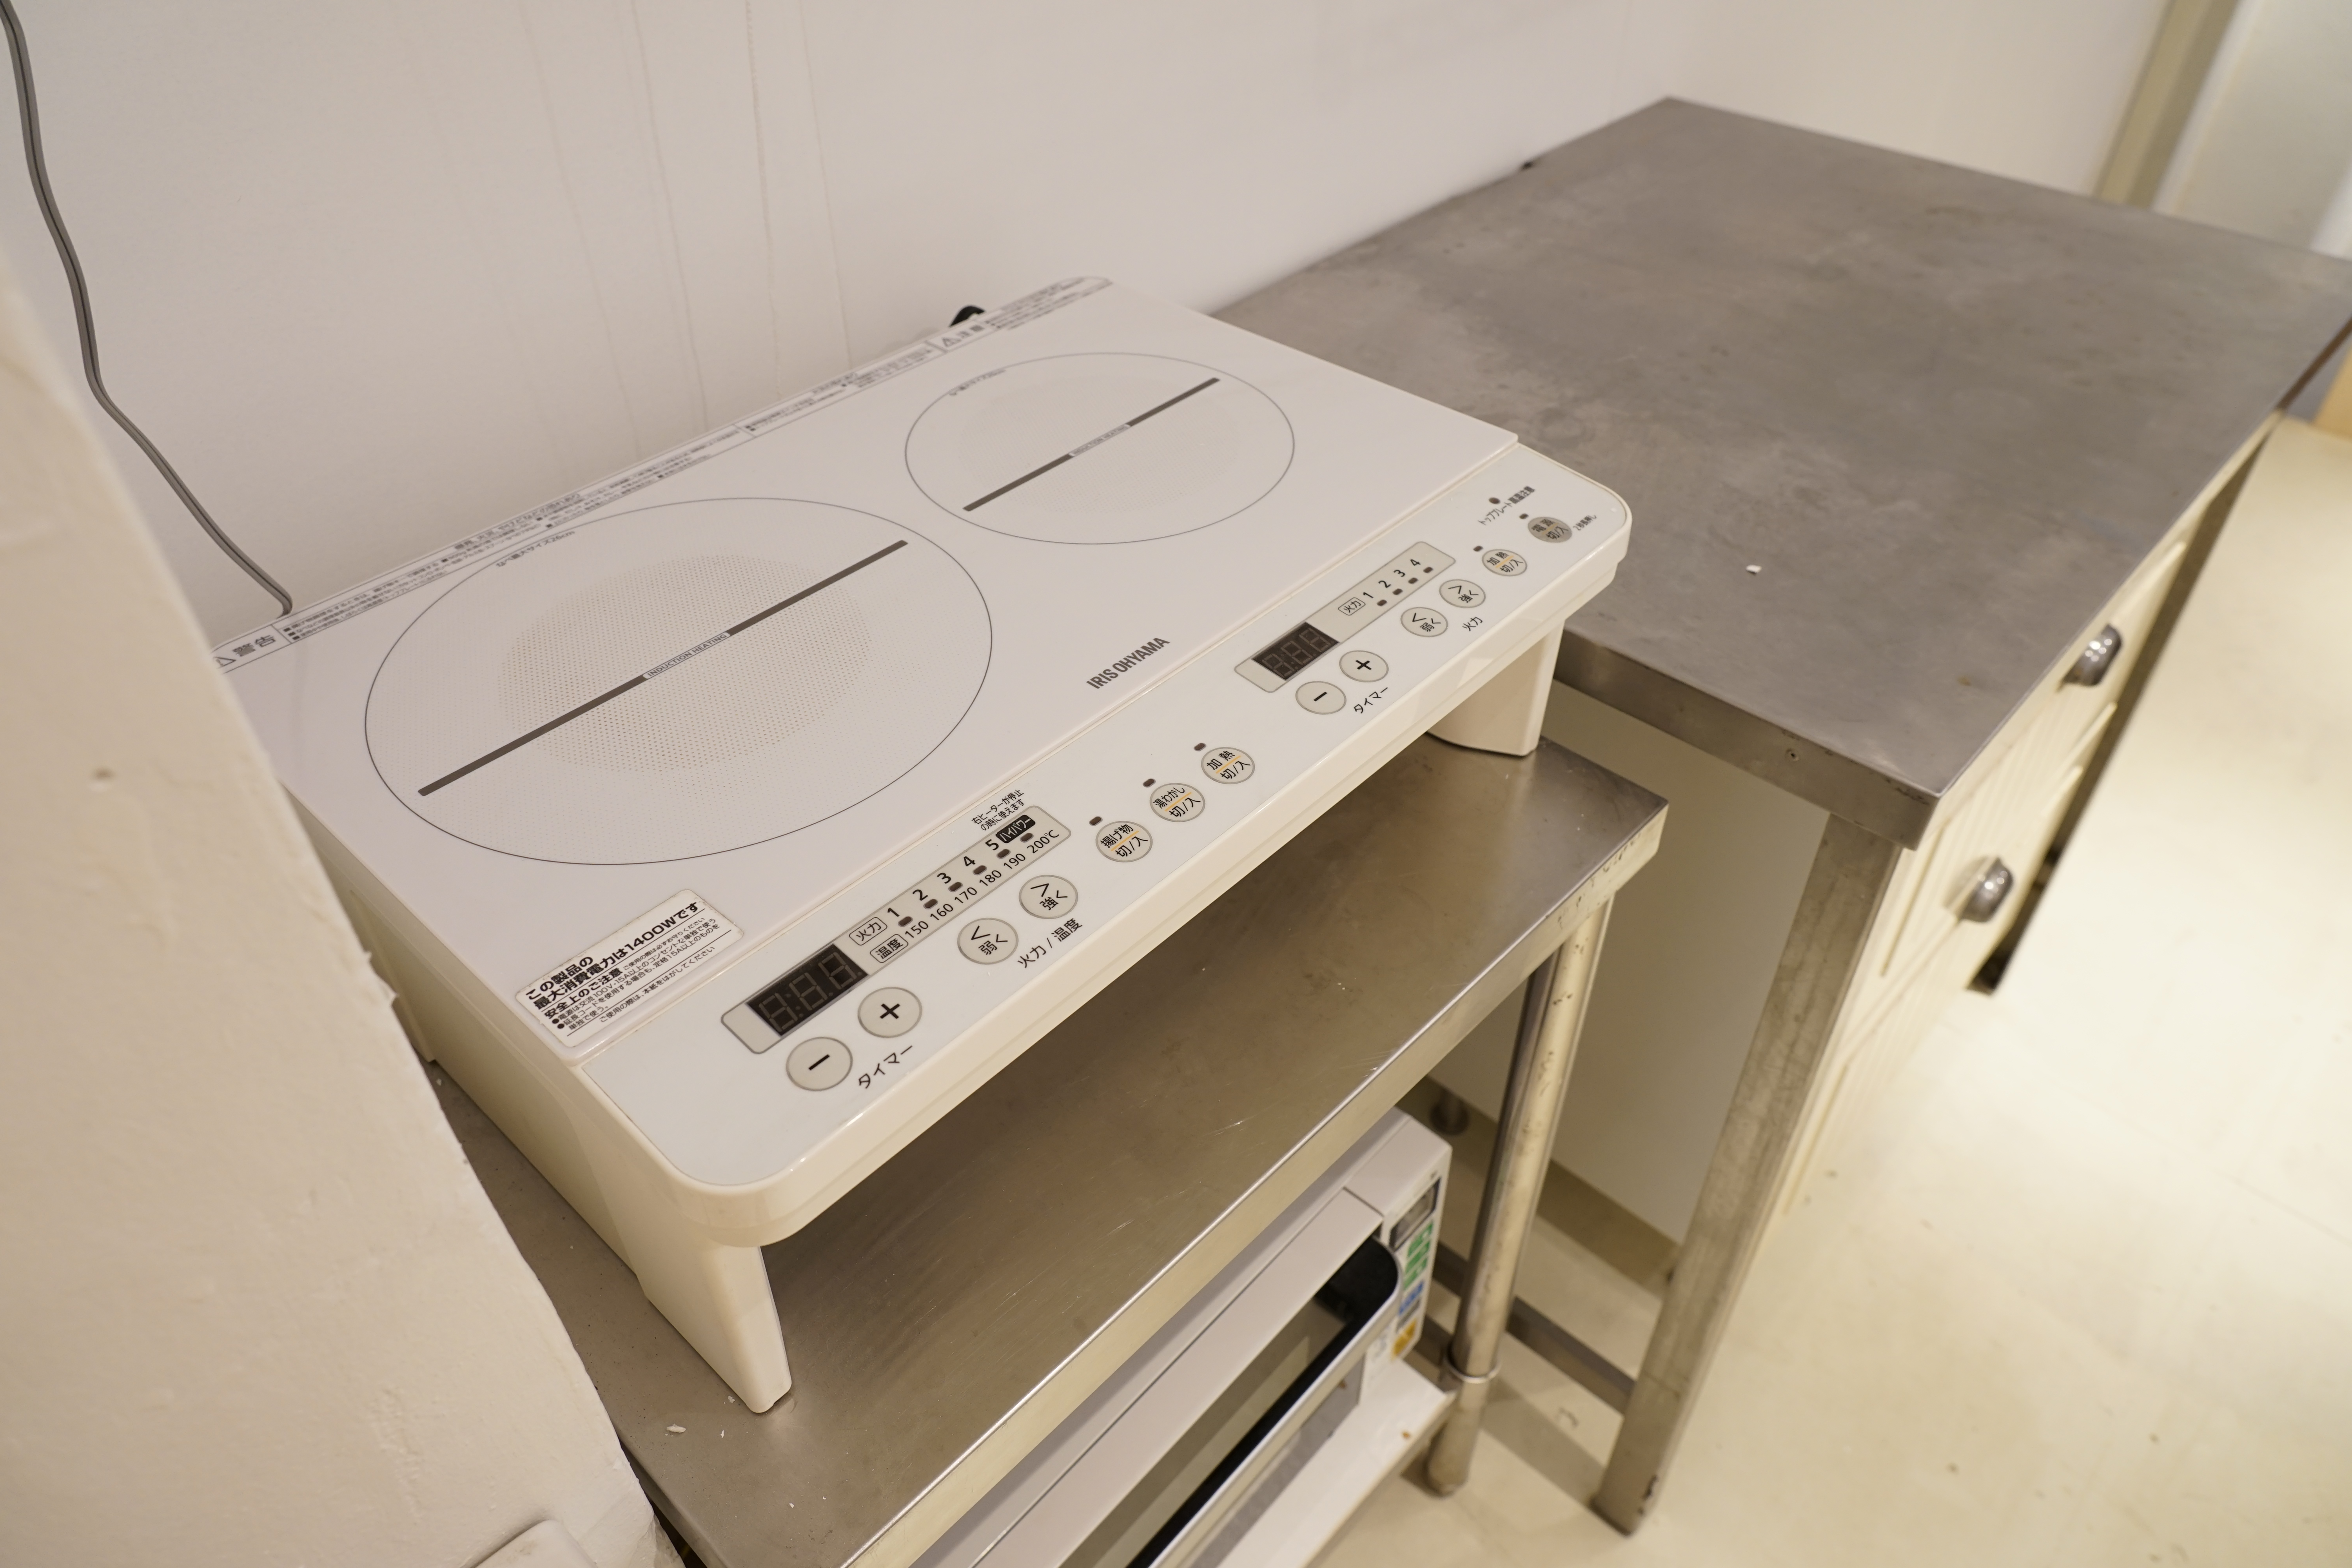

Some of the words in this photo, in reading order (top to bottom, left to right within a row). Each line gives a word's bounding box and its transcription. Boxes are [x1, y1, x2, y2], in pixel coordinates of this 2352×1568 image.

[1343, 601, 1361, 613] 火力
[1393, 569, 1406, 577] 3
[1458, 590, 1479, 603] 強く
[1419, 618, 1441, 632] 弱く
[1462, 616, 1483, 632] 火力
[647, 652, 692, 677] INDUCTION
[693, 633, 727, 654] HEATING
[1086, 668, 1118, 689] IRIS
[1112, 637, 1170, 673] OHYAMA
[1354, 685, 1389, 715] タイマー
[1206, 750, 1235, 770] 加熱
[1220, 760, 1250, 780] 切/入
[971, 789, 1024, 824] 右ヒーターが停止
[1152, 787, 1185, 809] 湯わかし
[1169, 797, 1201, 818] 切/入
[980, 799, 1024, 831] の時に使えます
[1100, 824, 1134, 849] 揚げ物
[1115, 836, 1148, 857] 切/入
[856, 922, 882, 941] 火力
[887, 907, 900, 918] 1
[912, 889, 928, 901] 2
[936, 872, 951, 884] 3
[963, 855, 975, 867] 4
[985, 839, 999, 851] 5
[999, 818, 1031, 842] ハイパワー
[875, 938, 904, 959] 温度
[905, 920, 929, 938] 150
[930, 904, 953, 921] 160
[954, 887, 977, 904] 170
[978, 870, 1002, 886] 180
[1003, 853, 1026, 870] 190
[1039, 890, 1068, 911] 強く
[533, 902, 698, 1010] 最大消費電力は1400Wです
[978, 934, 1008, 955] 弱く
[526, 956, 593, 1000] この製品の
[544, 967, 623, 1019] 安全上のご注意
[623, 917, 705, 971] ご使用の際は必ずお守りください
[563, 924, 720, 1026] 延長コードを使用する場合も、定格15A以上のものを
[599, 946, 715, 1023] ご使用の際は、本紙をはがしてください
[568, 1005, 608, 1030] 単独で使う。
[858, 1045, 913, 1089] タイマー
